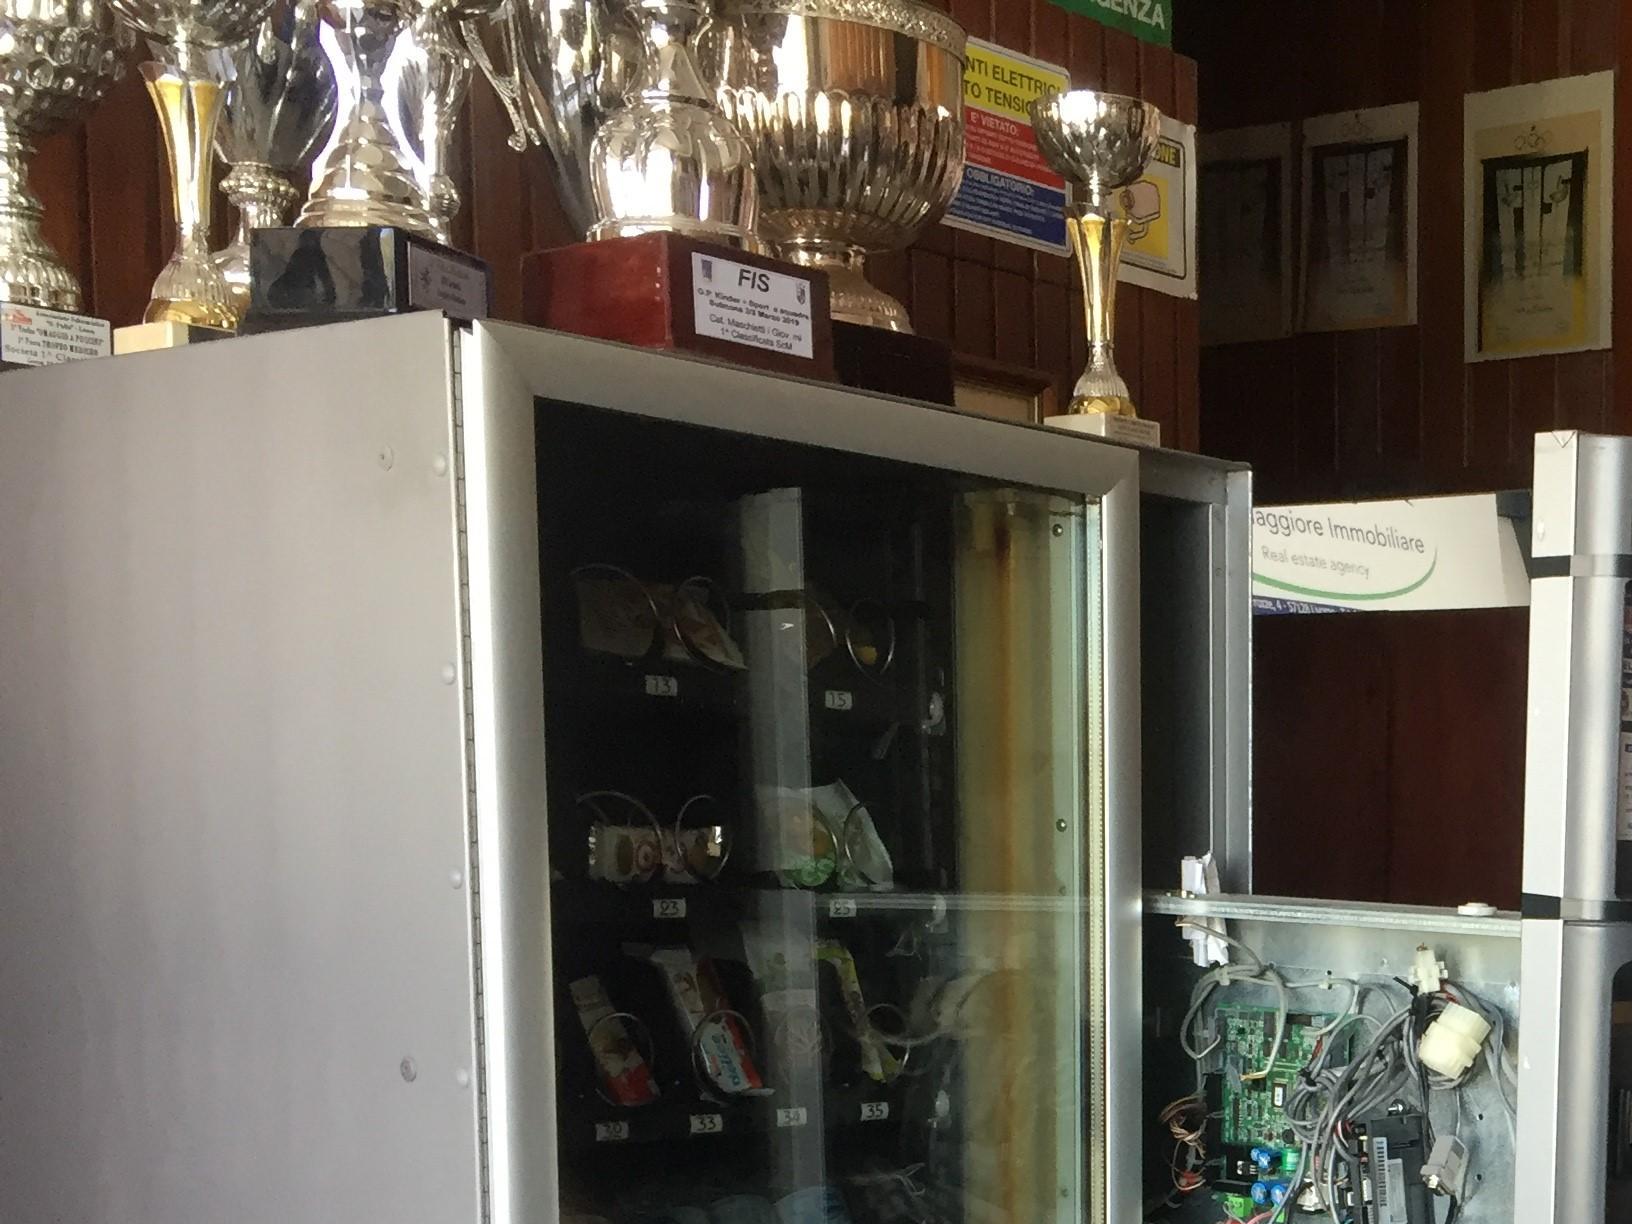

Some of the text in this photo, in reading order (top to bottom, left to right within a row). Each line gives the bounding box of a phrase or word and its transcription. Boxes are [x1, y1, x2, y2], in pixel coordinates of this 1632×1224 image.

[966, 55, 988, 76] NTI
[963, 79, 982, 99] TO
[738, 268, 770, 292] FIS
[1251, 508, 1425, 554] aggiore Immobiliare
[1261, 545, 1370, 580] Real estate agency
